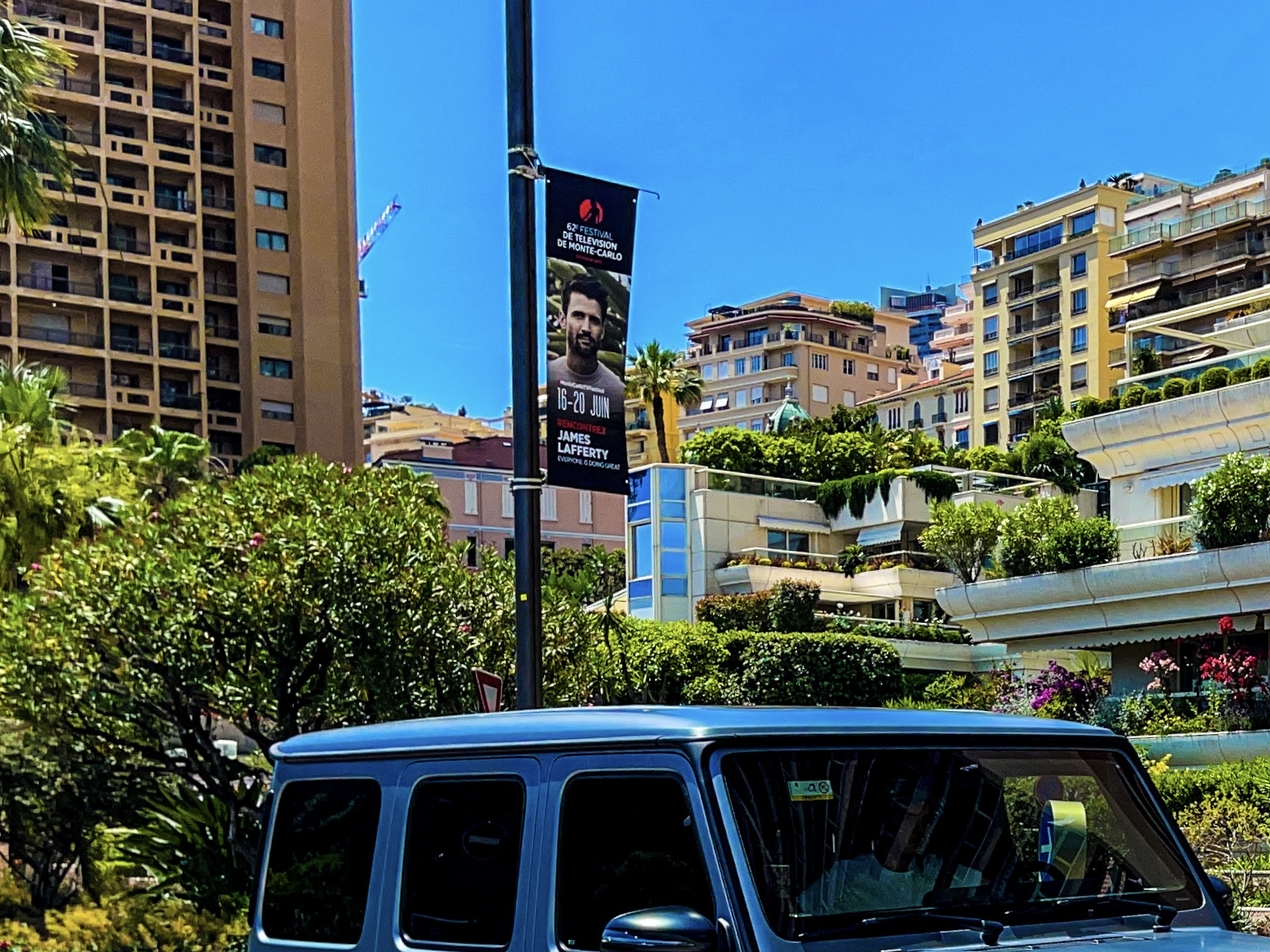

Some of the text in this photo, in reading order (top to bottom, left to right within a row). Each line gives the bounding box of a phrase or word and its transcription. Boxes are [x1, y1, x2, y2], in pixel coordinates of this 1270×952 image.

[562, 230, 618, 251] DE TELEVISION
[580, 226, 613, 240] FESTIVAL
[557, 238, 567, 249] DE
[568, 242, 623, 261] MONTE-CARLO
[557, 387, 610, 419] 16-20 JUIN
[557, 430, 591, 445] JAMES
[558, 442, 609, 460] LAFFERTY
[557, 455, 582, 465] EVERYONE
[589, 460, 604, 468] DOING
